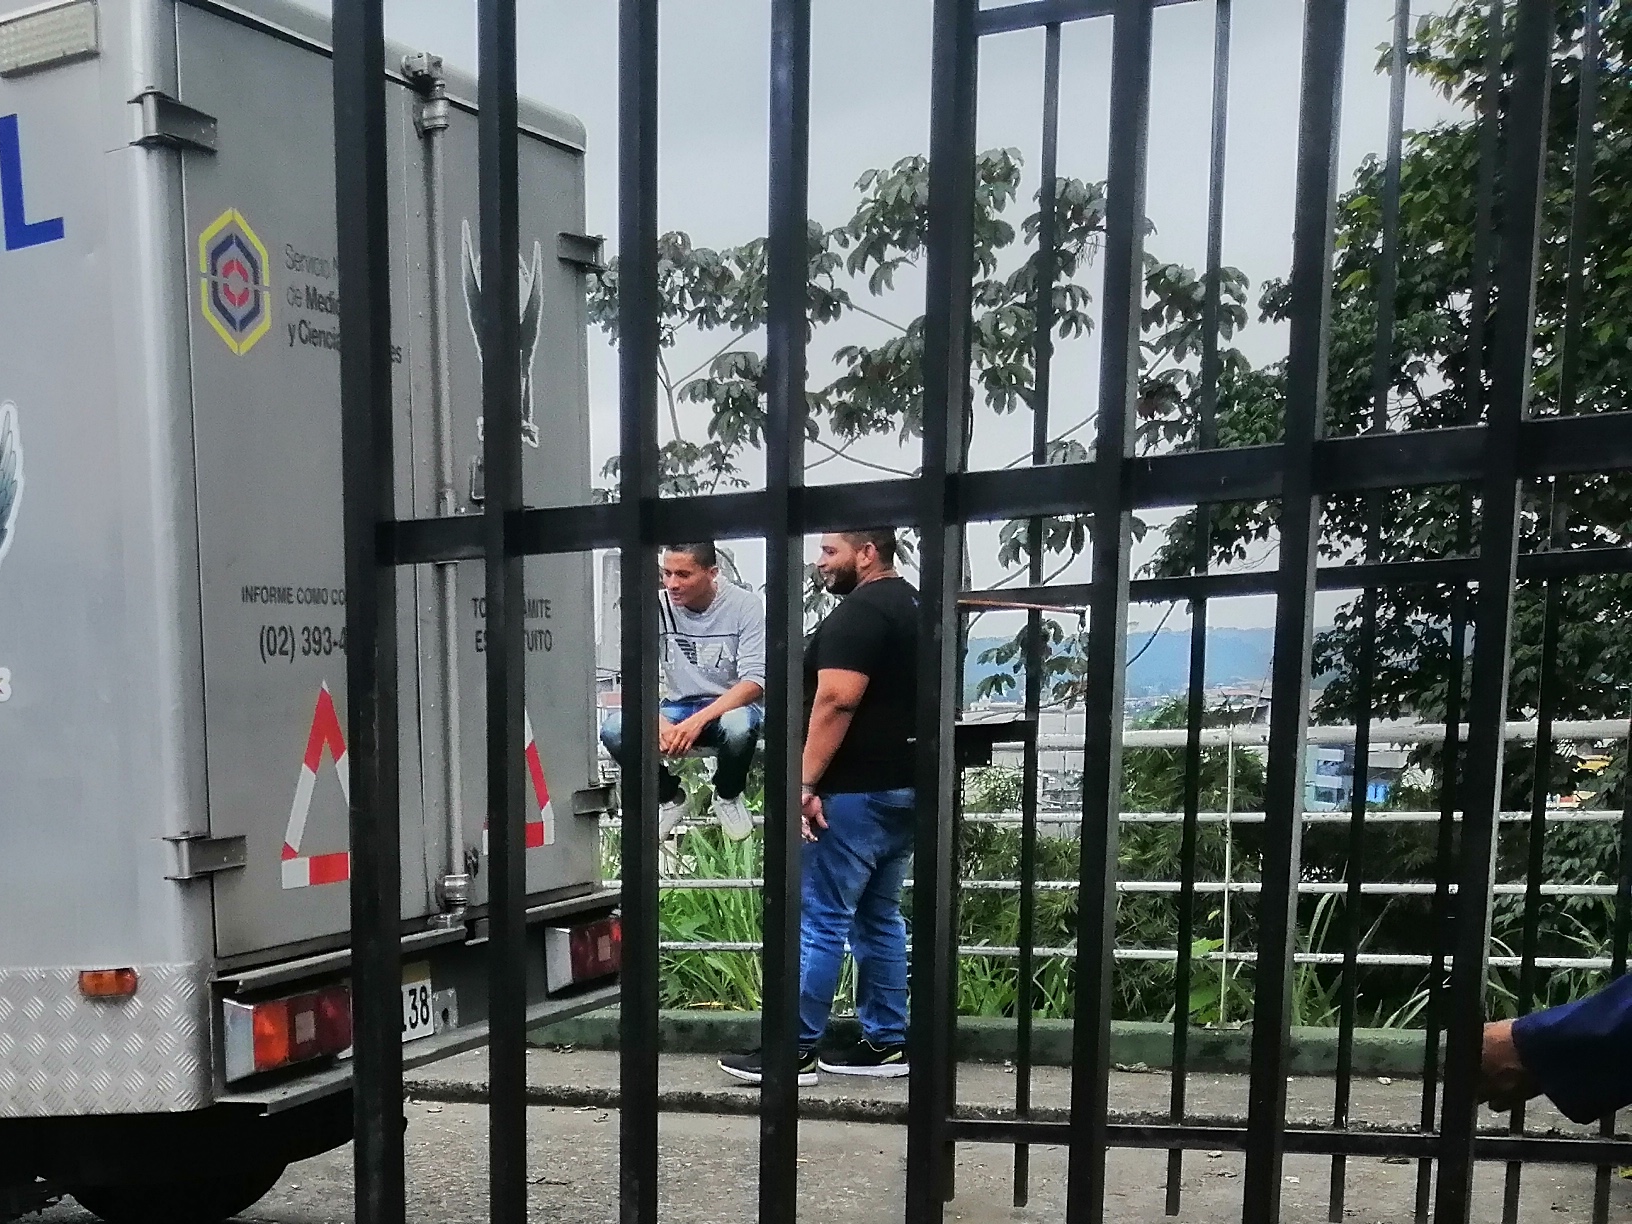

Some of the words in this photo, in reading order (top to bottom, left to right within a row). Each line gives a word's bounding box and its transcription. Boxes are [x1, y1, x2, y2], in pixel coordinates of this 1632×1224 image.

[288, 322, 296, 347] y
[241, 585, 295, 605] INFORME
[296, 587, 328, 605] COMO
[259, 625, 295, 664] (02)
